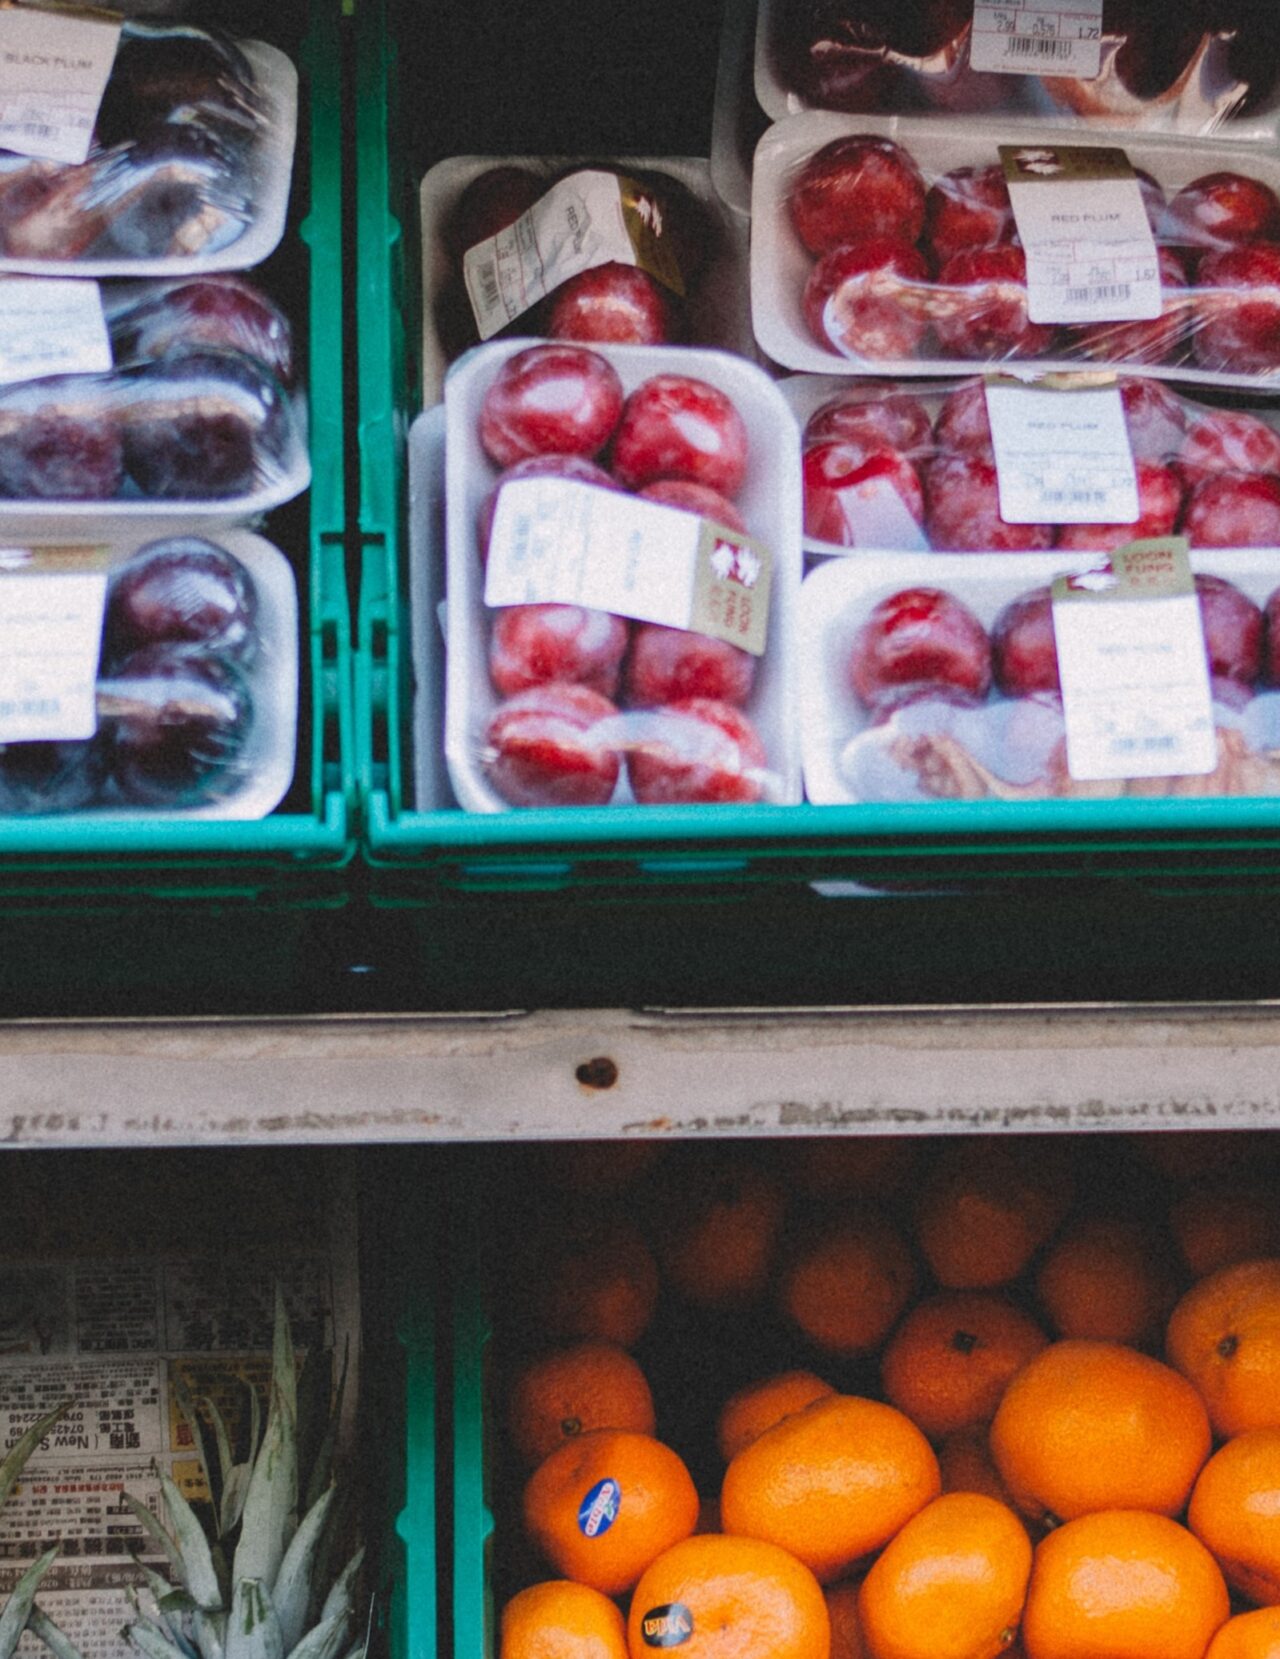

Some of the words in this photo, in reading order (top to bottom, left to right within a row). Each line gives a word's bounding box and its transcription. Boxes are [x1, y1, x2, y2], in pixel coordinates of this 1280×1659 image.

[1078, 27, 1100, 39] 1.72
[6, 52, 49, 66] BLACK
[54, 57, 93, 69] PLUM
[565, 206, 579, 231] RED
[1051, 214, 1080, 223] RED
[1083, 213, 1120, 222] PLUM
[9, 1424, 84, 1437] 07425789
[54, 1435, 89, 1449] New
